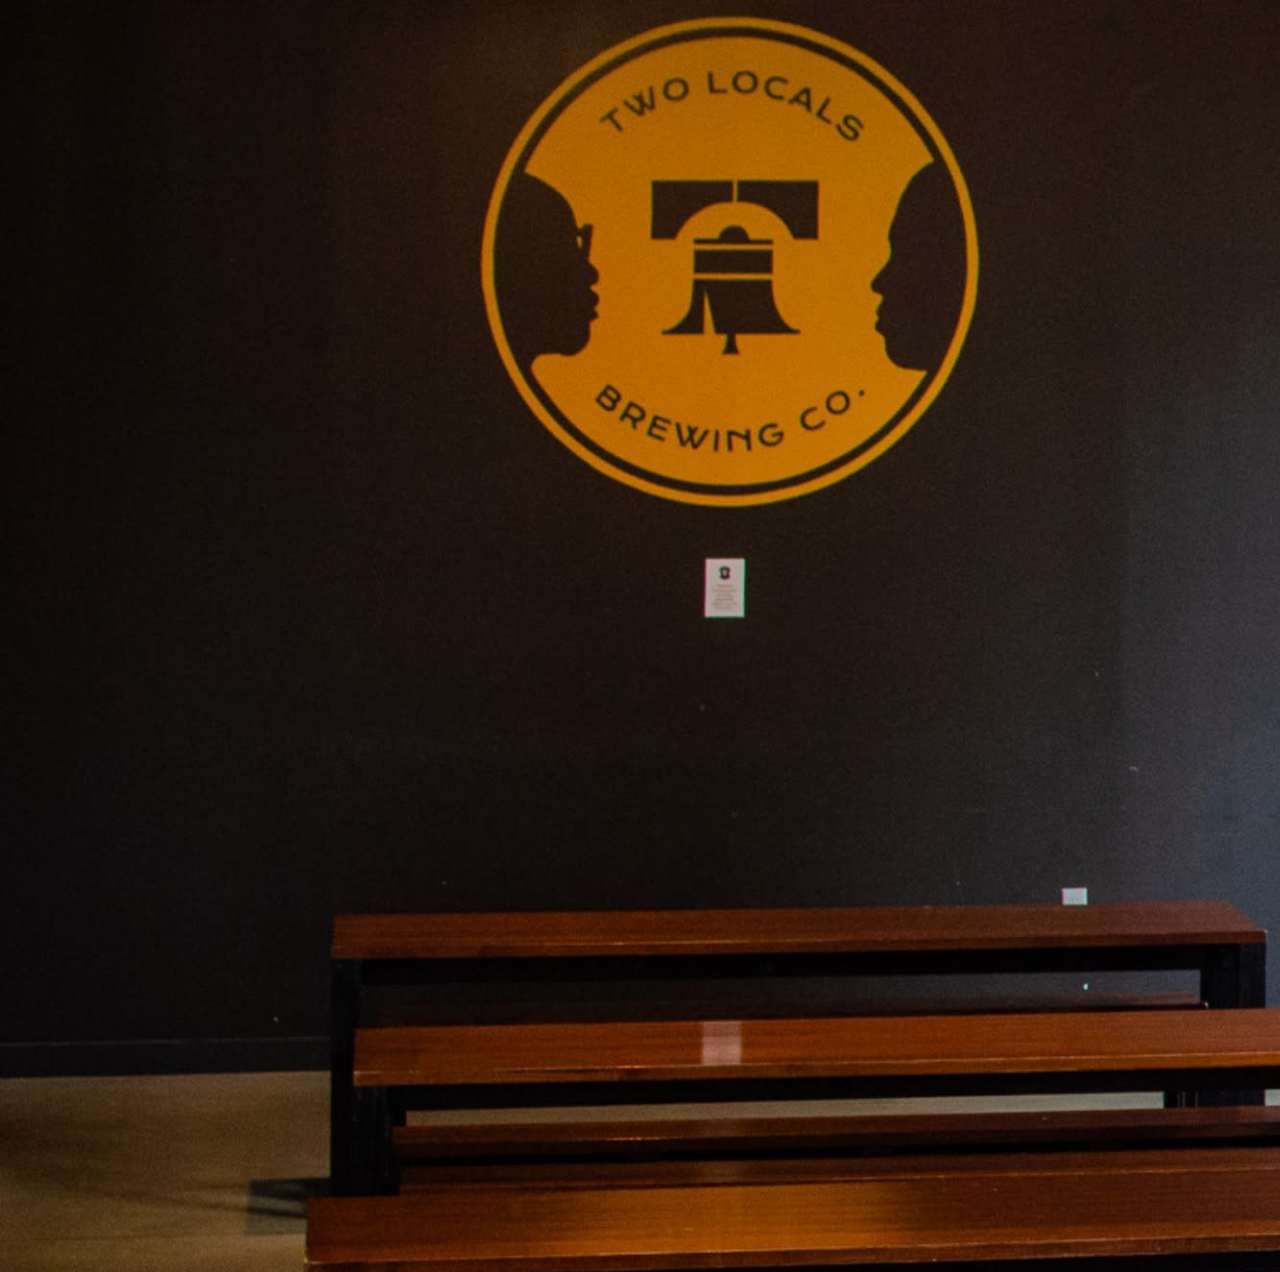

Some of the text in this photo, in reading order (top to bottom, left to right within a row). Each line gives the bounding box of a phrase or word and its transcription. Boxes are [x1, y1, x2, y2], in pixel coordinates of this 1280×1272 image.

[600, 71, 865, 142] TWO LOCALS
[594, 384, 866, 453] BREWING CO.
